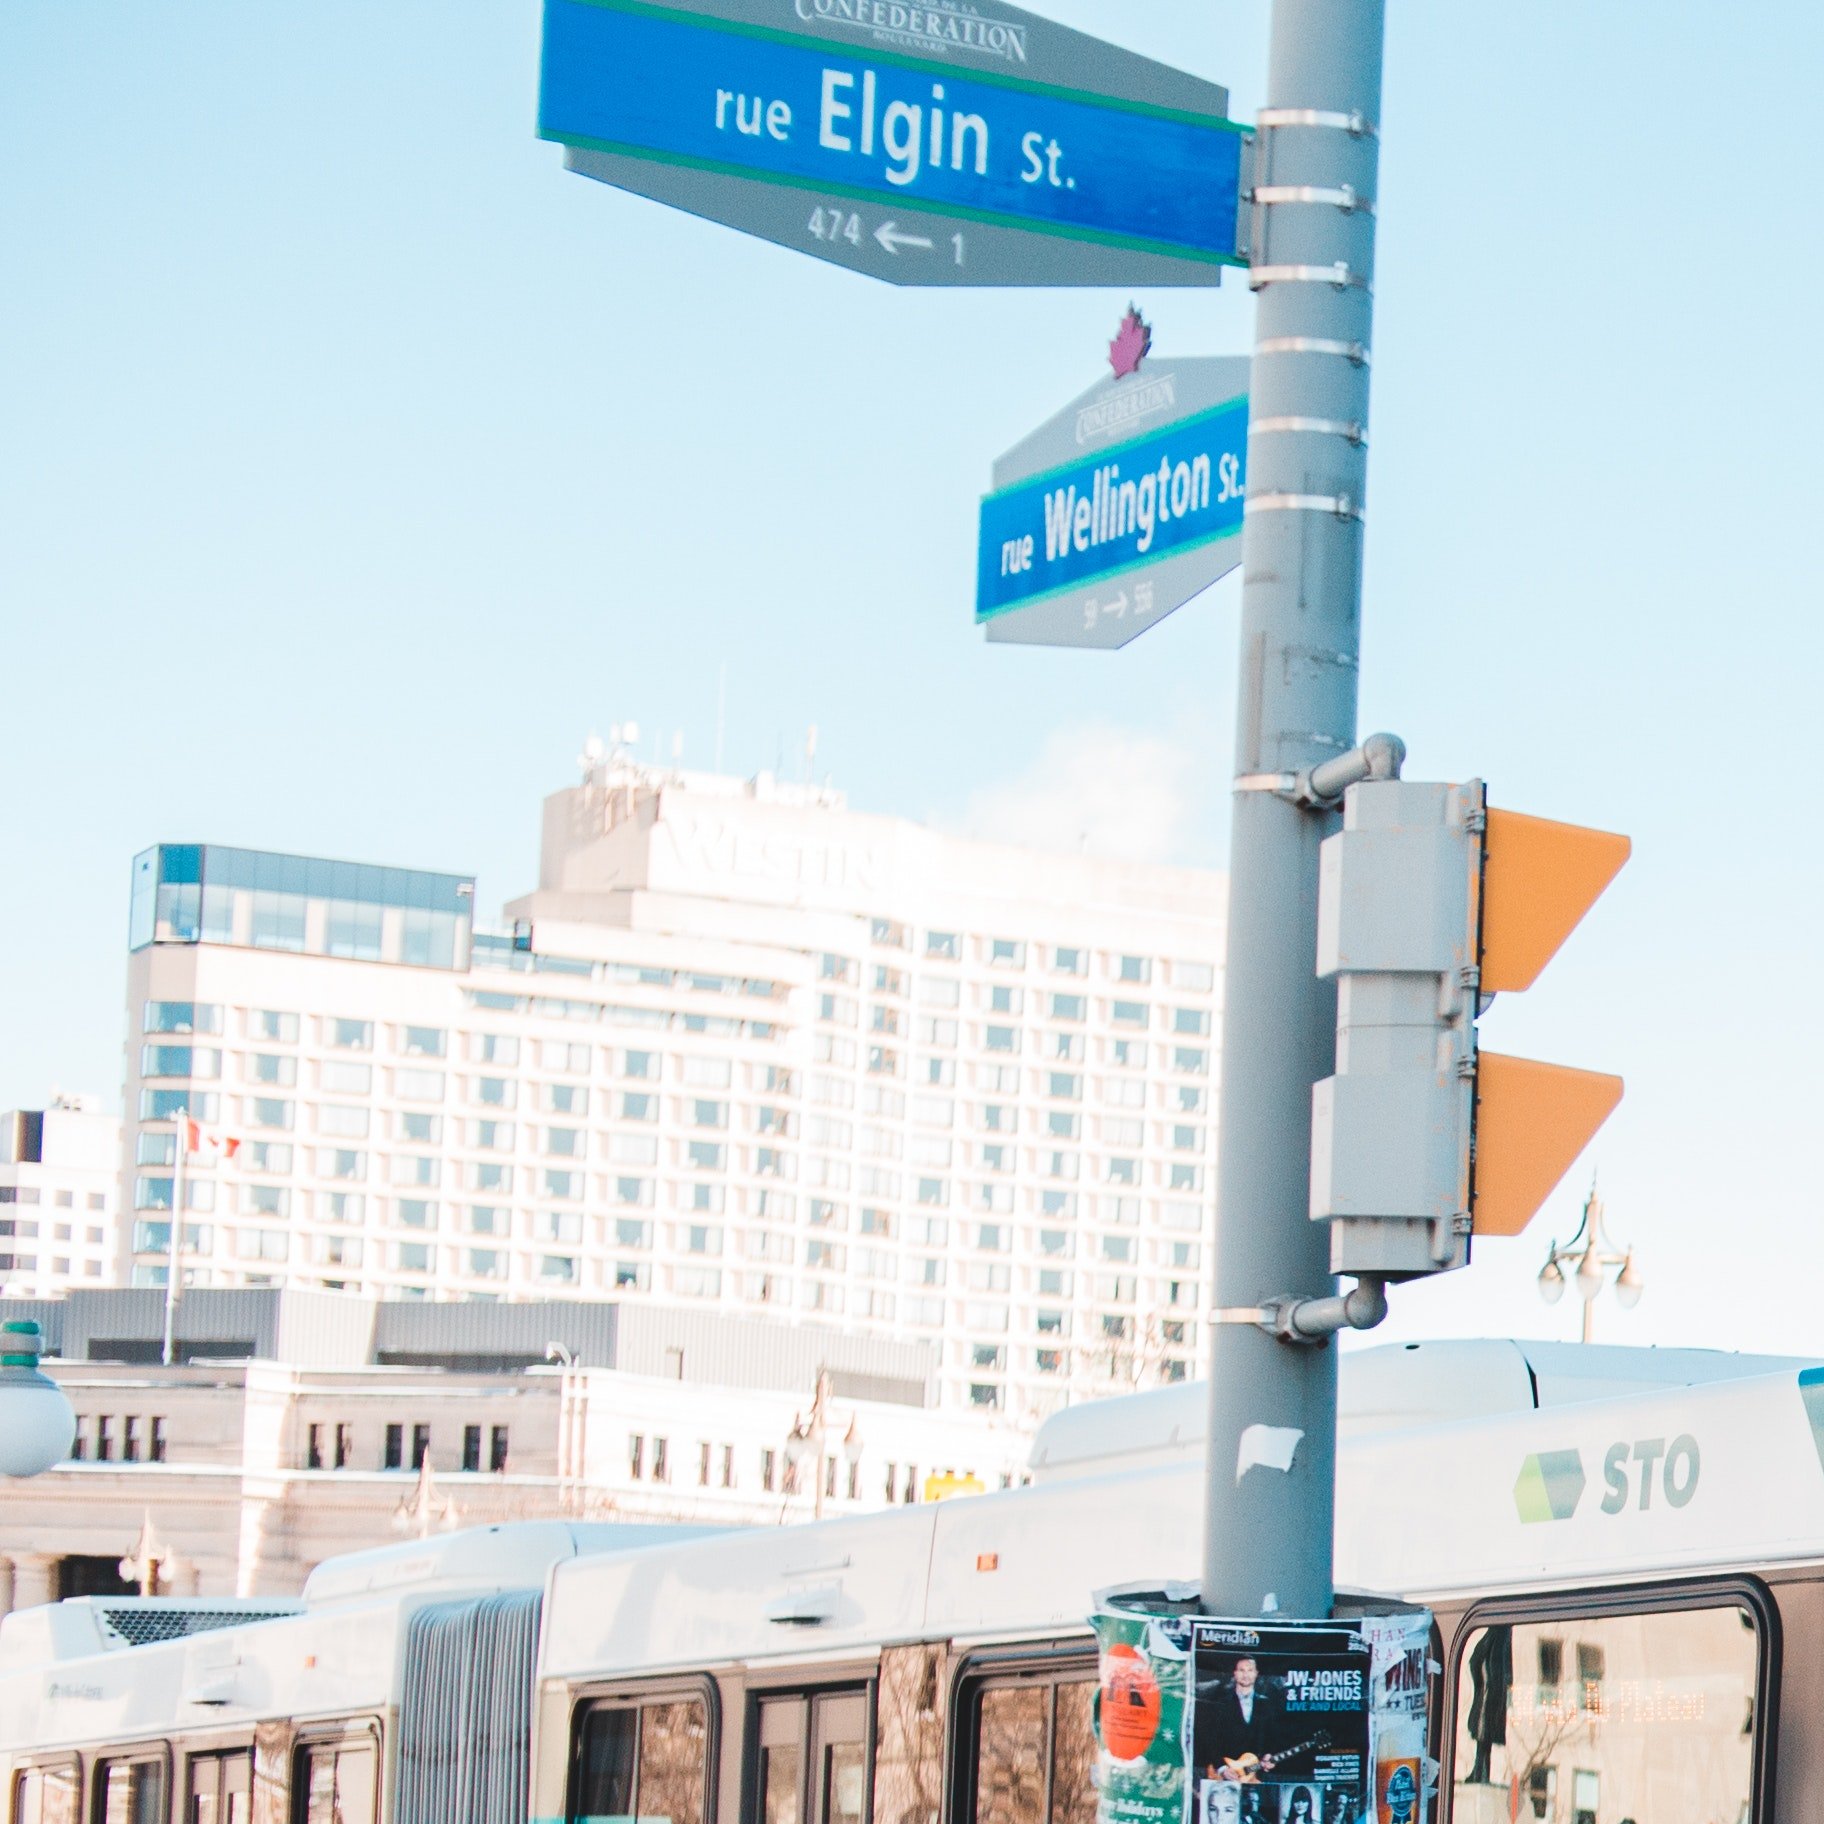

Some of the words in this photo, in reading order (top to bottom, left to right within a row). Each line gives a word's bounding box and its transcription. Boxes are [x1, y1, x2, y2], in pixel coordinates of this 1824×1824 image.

[795, 0, 1026, 62] CONFEDERATION
[715, 84, 792, 141] rue
[819, 68, 988, 186] Elgin
[1020, 131, 1076, 189] St.
[807, 206, 861, 246] 474
[951, 232, 965, 266] 1
[1001, 534, 1034, 577] rue
[1043, 454, 1211, 562] Wellington
[1217, 453, 1245, 503] St.
[1601, 1433, 1701, 1516] STO
[1200, 1629, 1260, 1646] Meridian
[1285, 1670, 1362, 1687] JW-JONES
[1286, 1689, 1298, 1701] &
[1300, 1686, 1362, 1702] FRIENDS
[1286, 1700, 1308, 1712] LIVE
[1332, 1700, 1362, 1711] LOCAL
